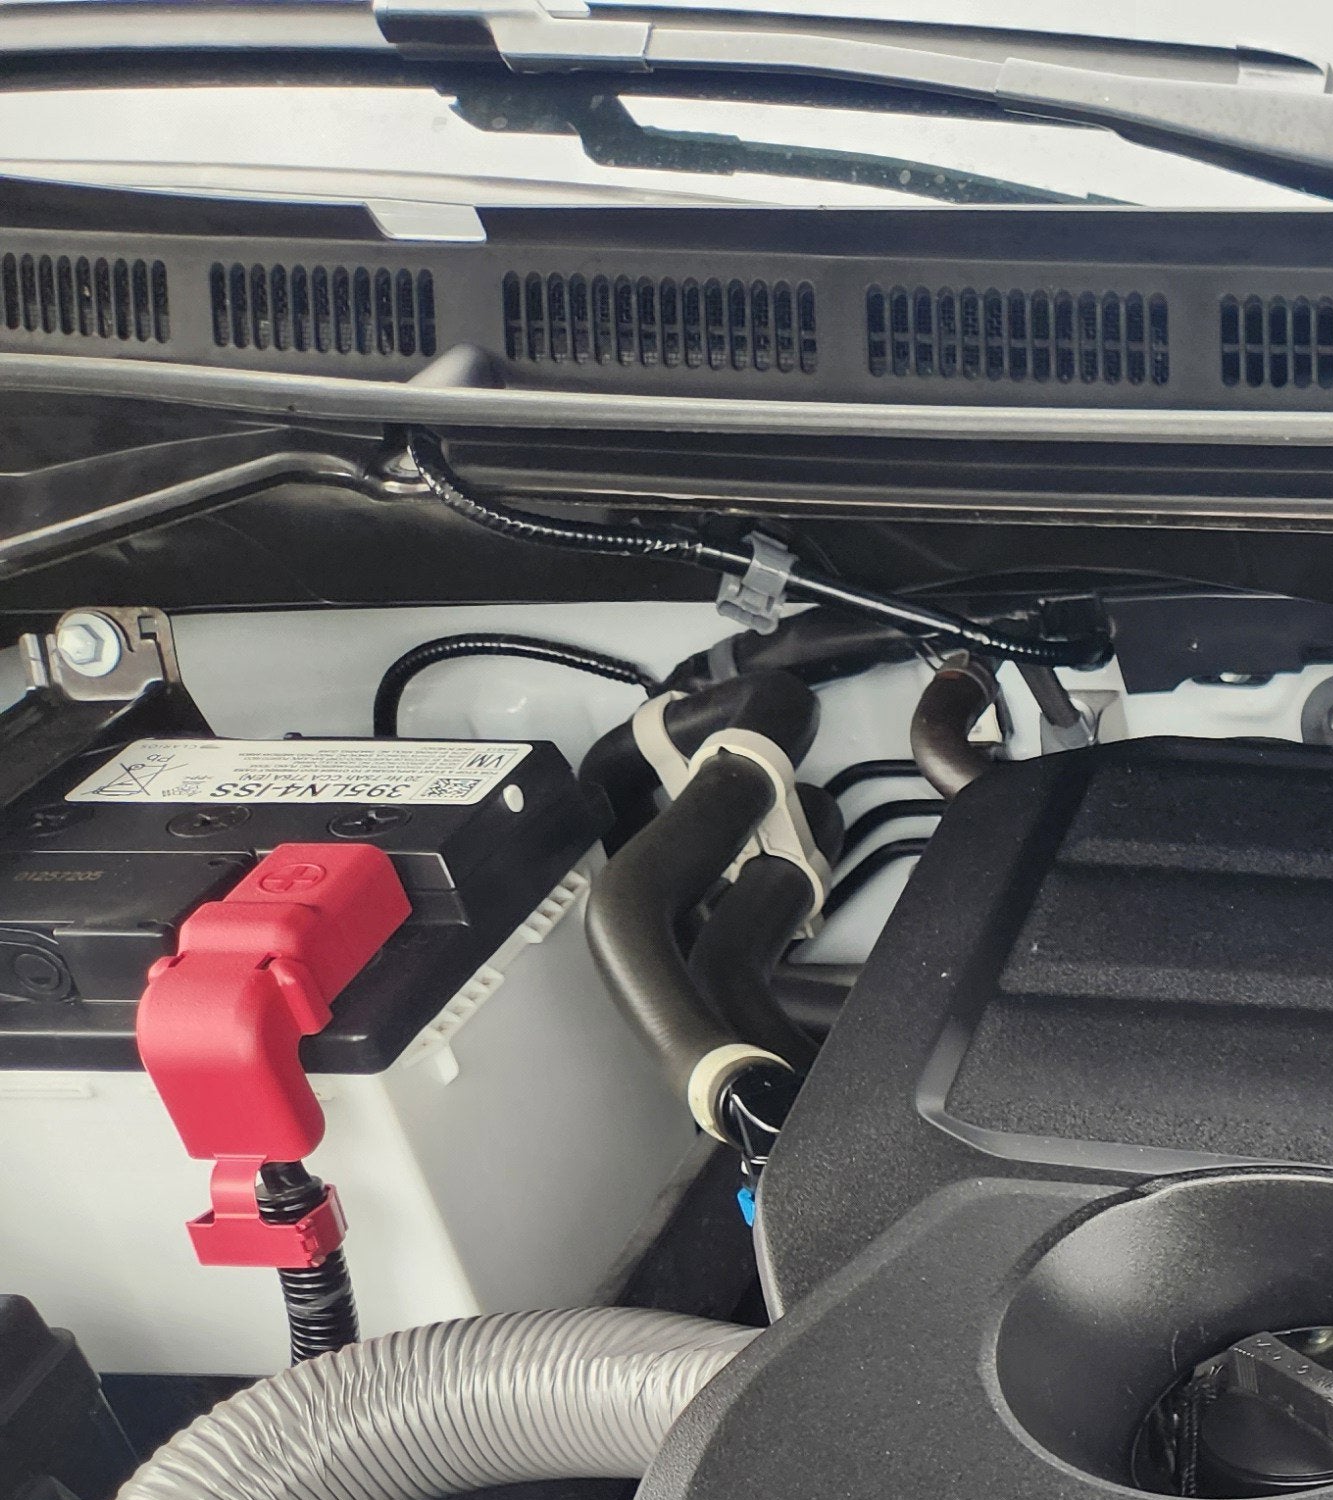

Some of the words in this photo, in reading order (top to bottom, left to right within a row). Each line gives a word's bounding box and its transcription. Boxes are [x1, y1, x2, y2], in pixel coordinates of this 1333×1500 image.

[146, 753, 176, 763] Pb
[466, 754, 505, 768] VM
[209, 782, 411, 799] 395LN4-ISS
